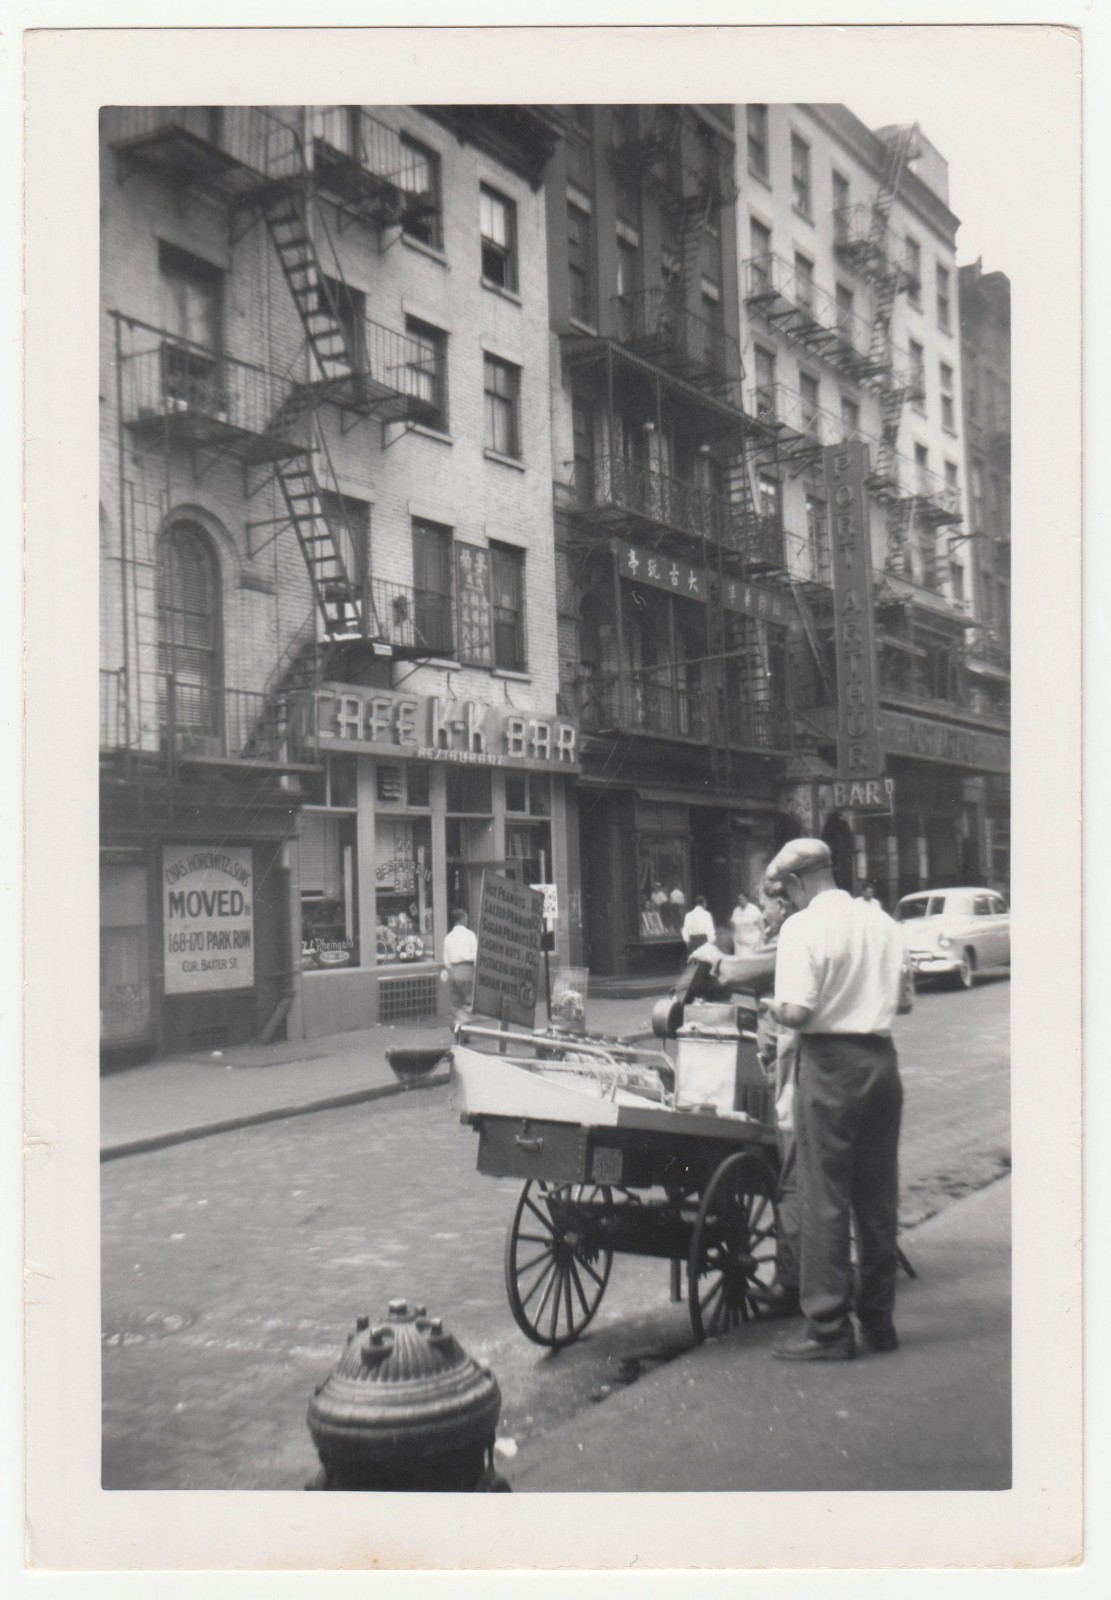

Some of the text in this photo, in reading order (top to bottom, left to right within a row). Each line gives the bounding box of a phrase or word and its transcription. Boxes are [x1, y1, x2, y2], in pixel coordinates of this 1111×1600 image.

[833, 453, 867, 778] PORT ARTHUR
[313, 690, 417, 747] CAFE
[506, 716, 575, 763] BAR
[417, 747, 503, 765] RESTAURANT
[833, 780, 881, 807] BAR
[187, 853, 231, 873] HOROWITZ
[168, 890, 244, 919] MOVED
[497, 886, 525, 909] PEANUTS
[483, 899, 506, 920] SALTED
[168, 930, 251, 952] 168-170 PARK ROW
[502, 925, 529, 947] PEANUTS
[504, 945, 520, 960] NUTS
[201, 958, 227, 971] BAXTER
